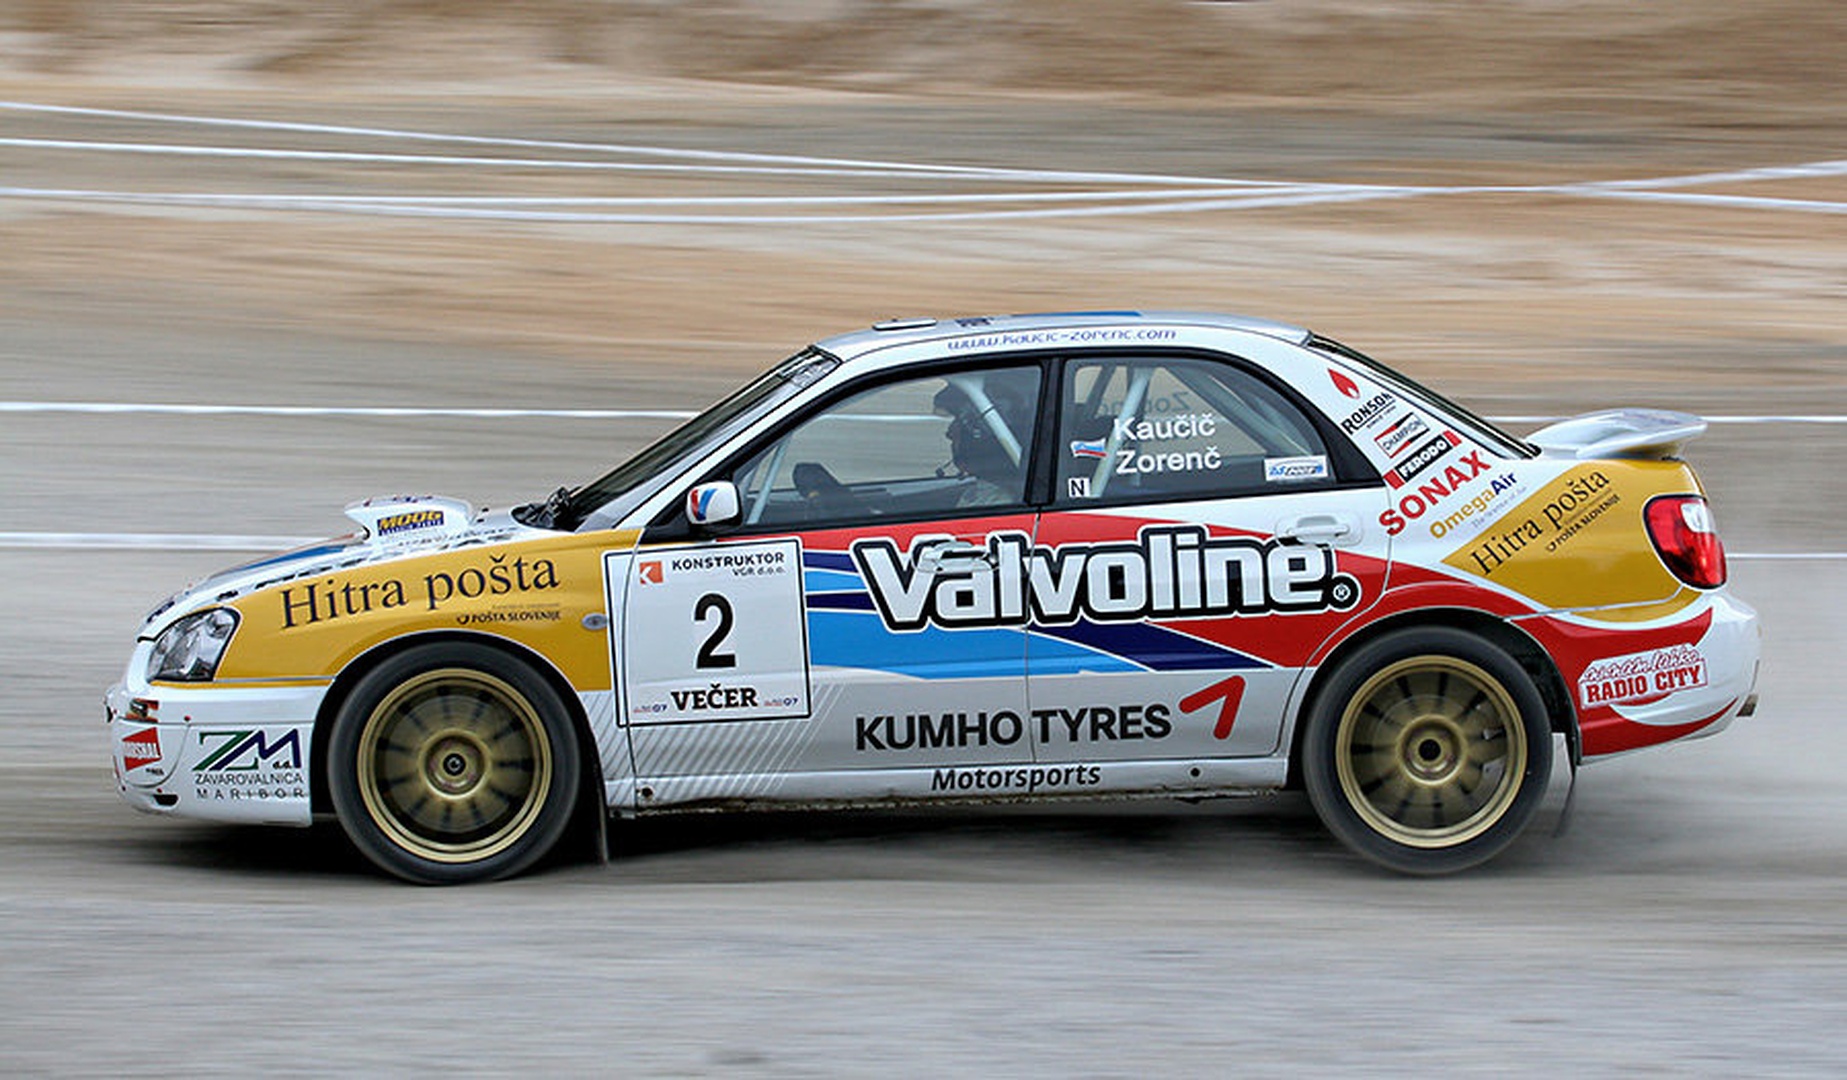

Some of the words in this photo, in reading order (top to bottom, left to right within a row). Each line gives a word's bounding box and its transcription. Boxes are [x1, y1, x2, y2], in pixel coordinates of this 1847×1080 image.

[1114, 412, 1216, 440] Kaučič
[1340, 391, 1393, 435] RONSON
[1116, 446, 1222, 474] Zorenč
[1399, 439, 1448, 479] FERODO
[1070, 480, 1086, 496] N
[1379, 450, 1492, 536] SONAX
[1471, 518, 1543, 575] Hitra
[1543, 471, 1610, 531] pošta
[672, 552, 785, 571] KONSTRUKTOR
[281, 577, 408, 630] Hitra
[424, 554, 560, 610] pošta
[694, 592, 736, 669] 2
[671, 683, 758, 711] VEČER
[1586, 675, 1648, 703] RADIO
[1654, 665, 1700, 691] CITY
[855, 710, 1023, 751] KUMHO
[1031, 703, 1172, 744] TYRES
[195, 772, 304, 785] ZAVAROVALNICA
[196, 788, 305, 800] MARIBOR
[931, 763, 1101, 793] Motorsports
